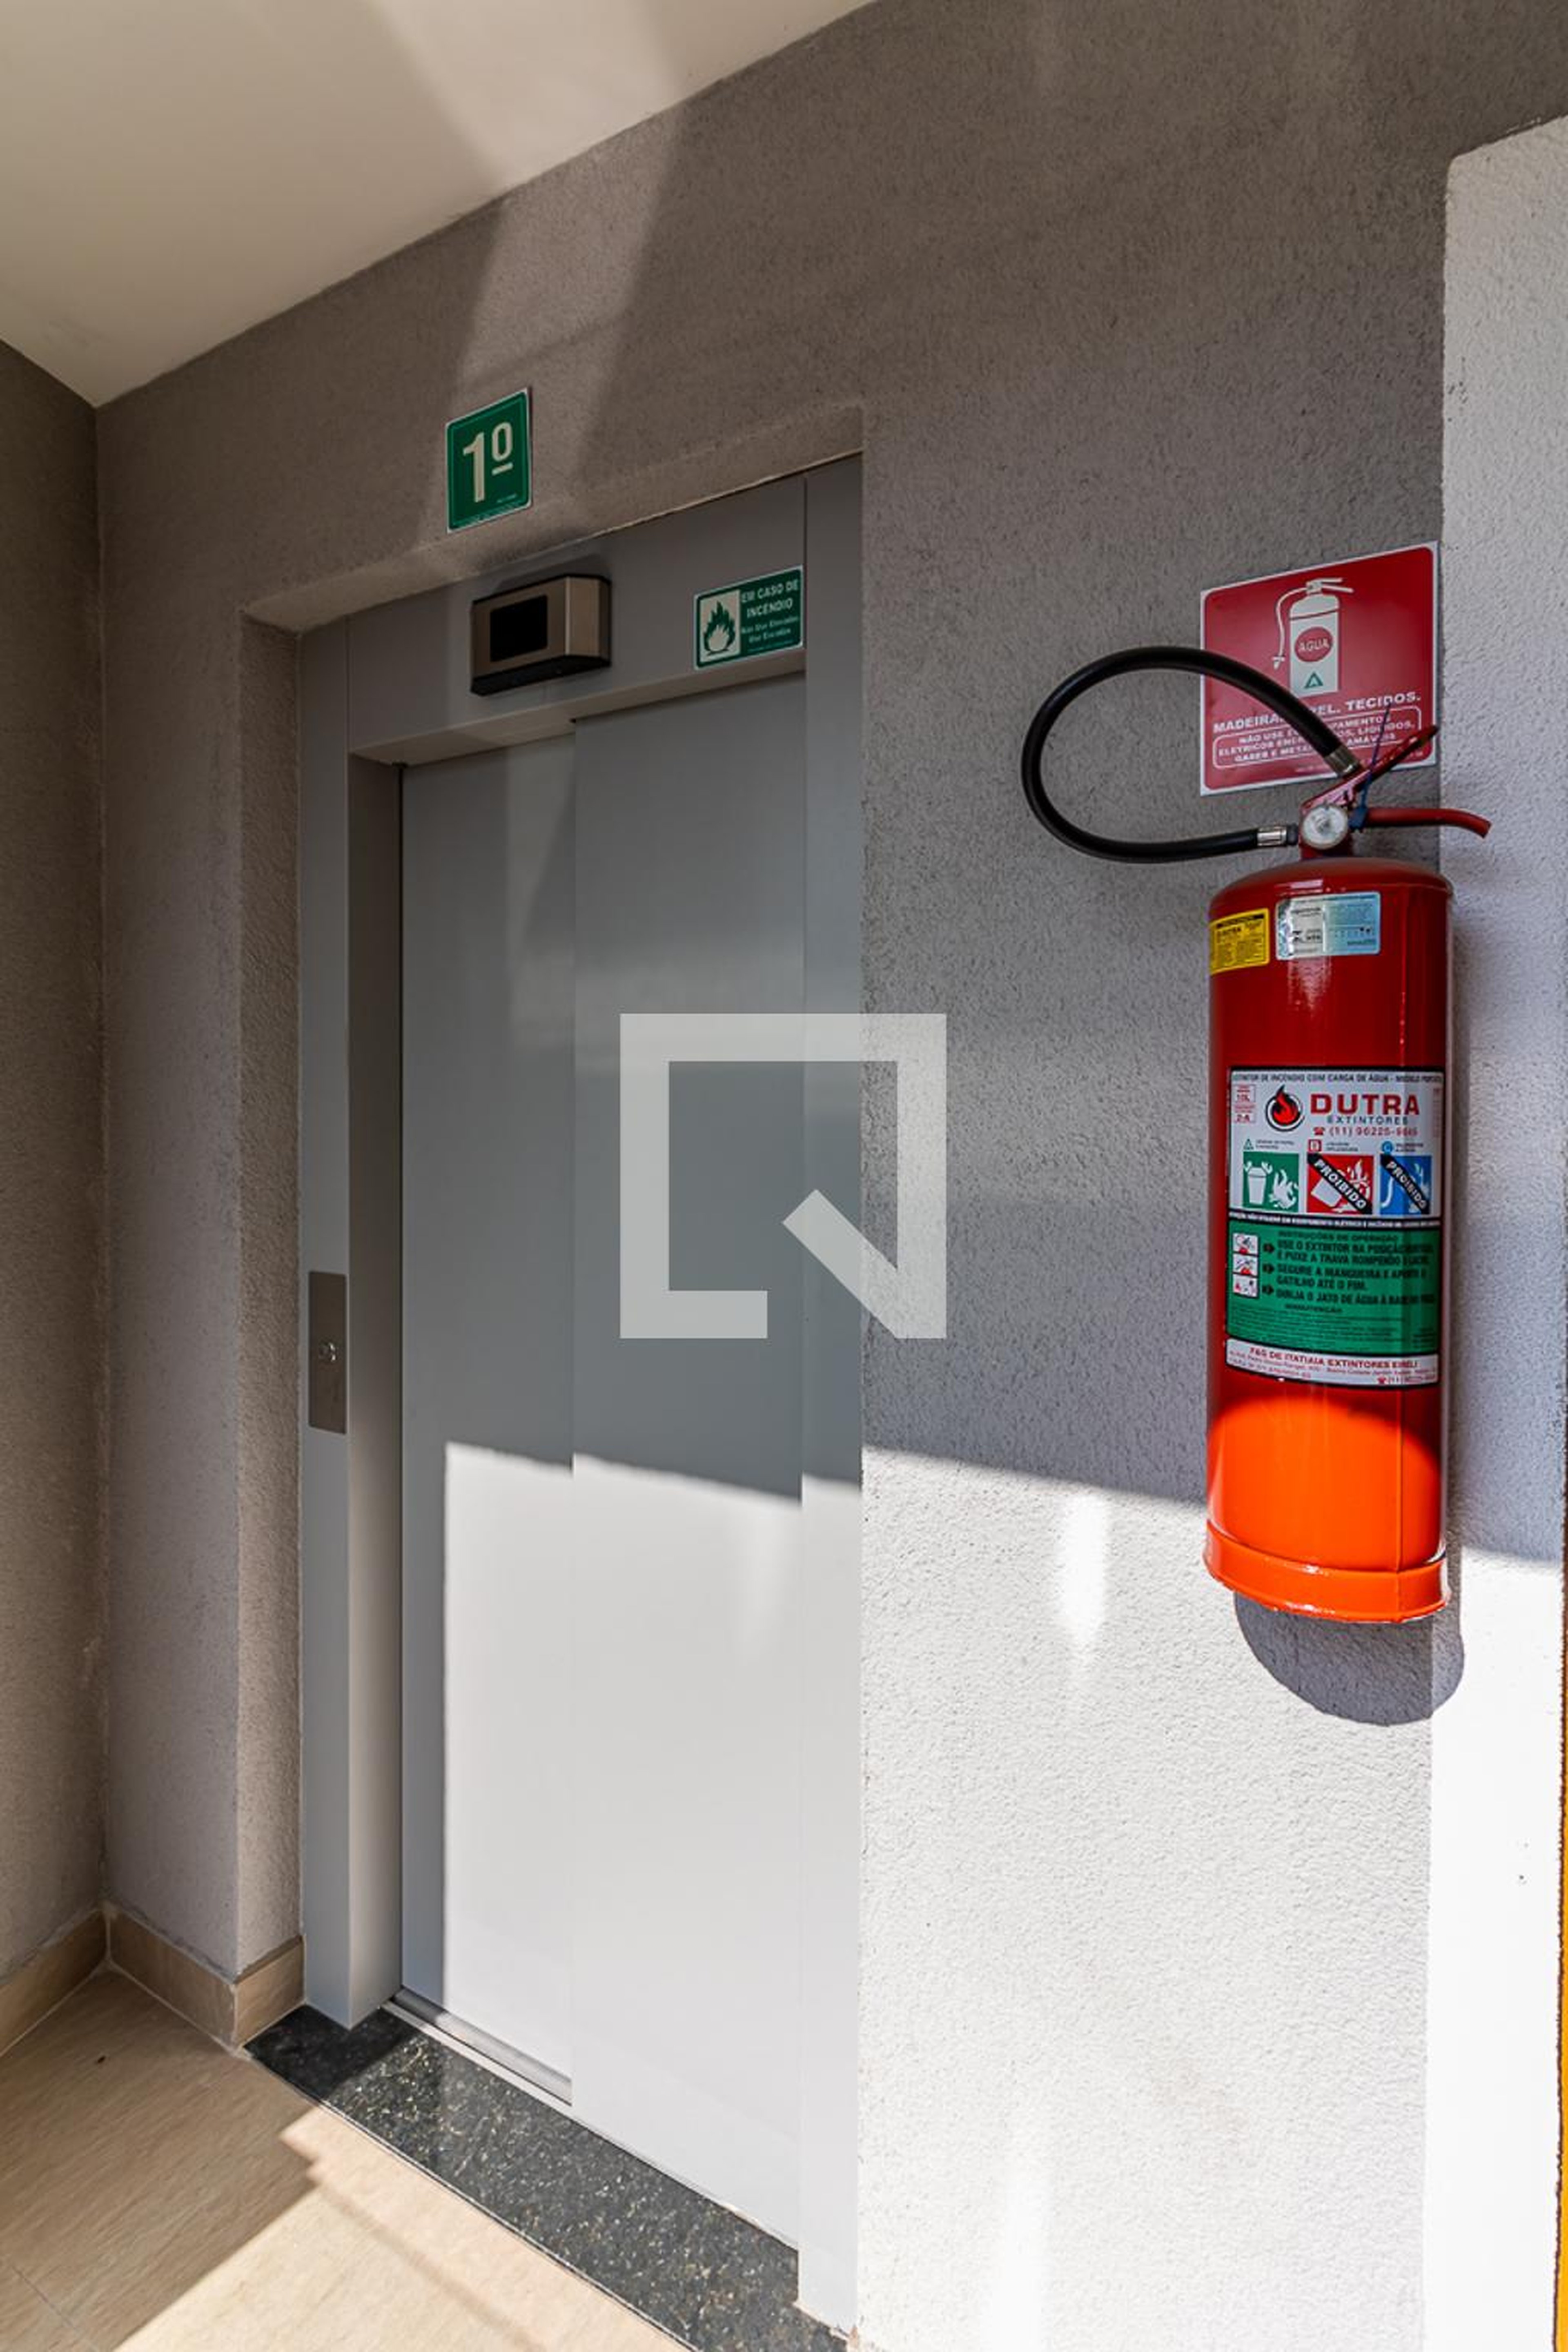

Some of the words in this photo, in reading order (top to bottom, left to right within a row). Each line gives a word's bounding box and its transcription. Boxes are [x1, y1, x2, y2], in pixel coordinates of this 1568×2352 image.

[463, 422, 513, 503] 1º
[757, 583, 784, 599] CASO
[785, 579, 799, 592] DE
[1310, 1093, 1420, 1116] DUTRA
[1327, 1116, 1408, 1125] EXTINTORES
[1314, 1159, 1367, 1209] PROIBIDO
[1386, 1161, 1427, 1209] PROIBIDO
